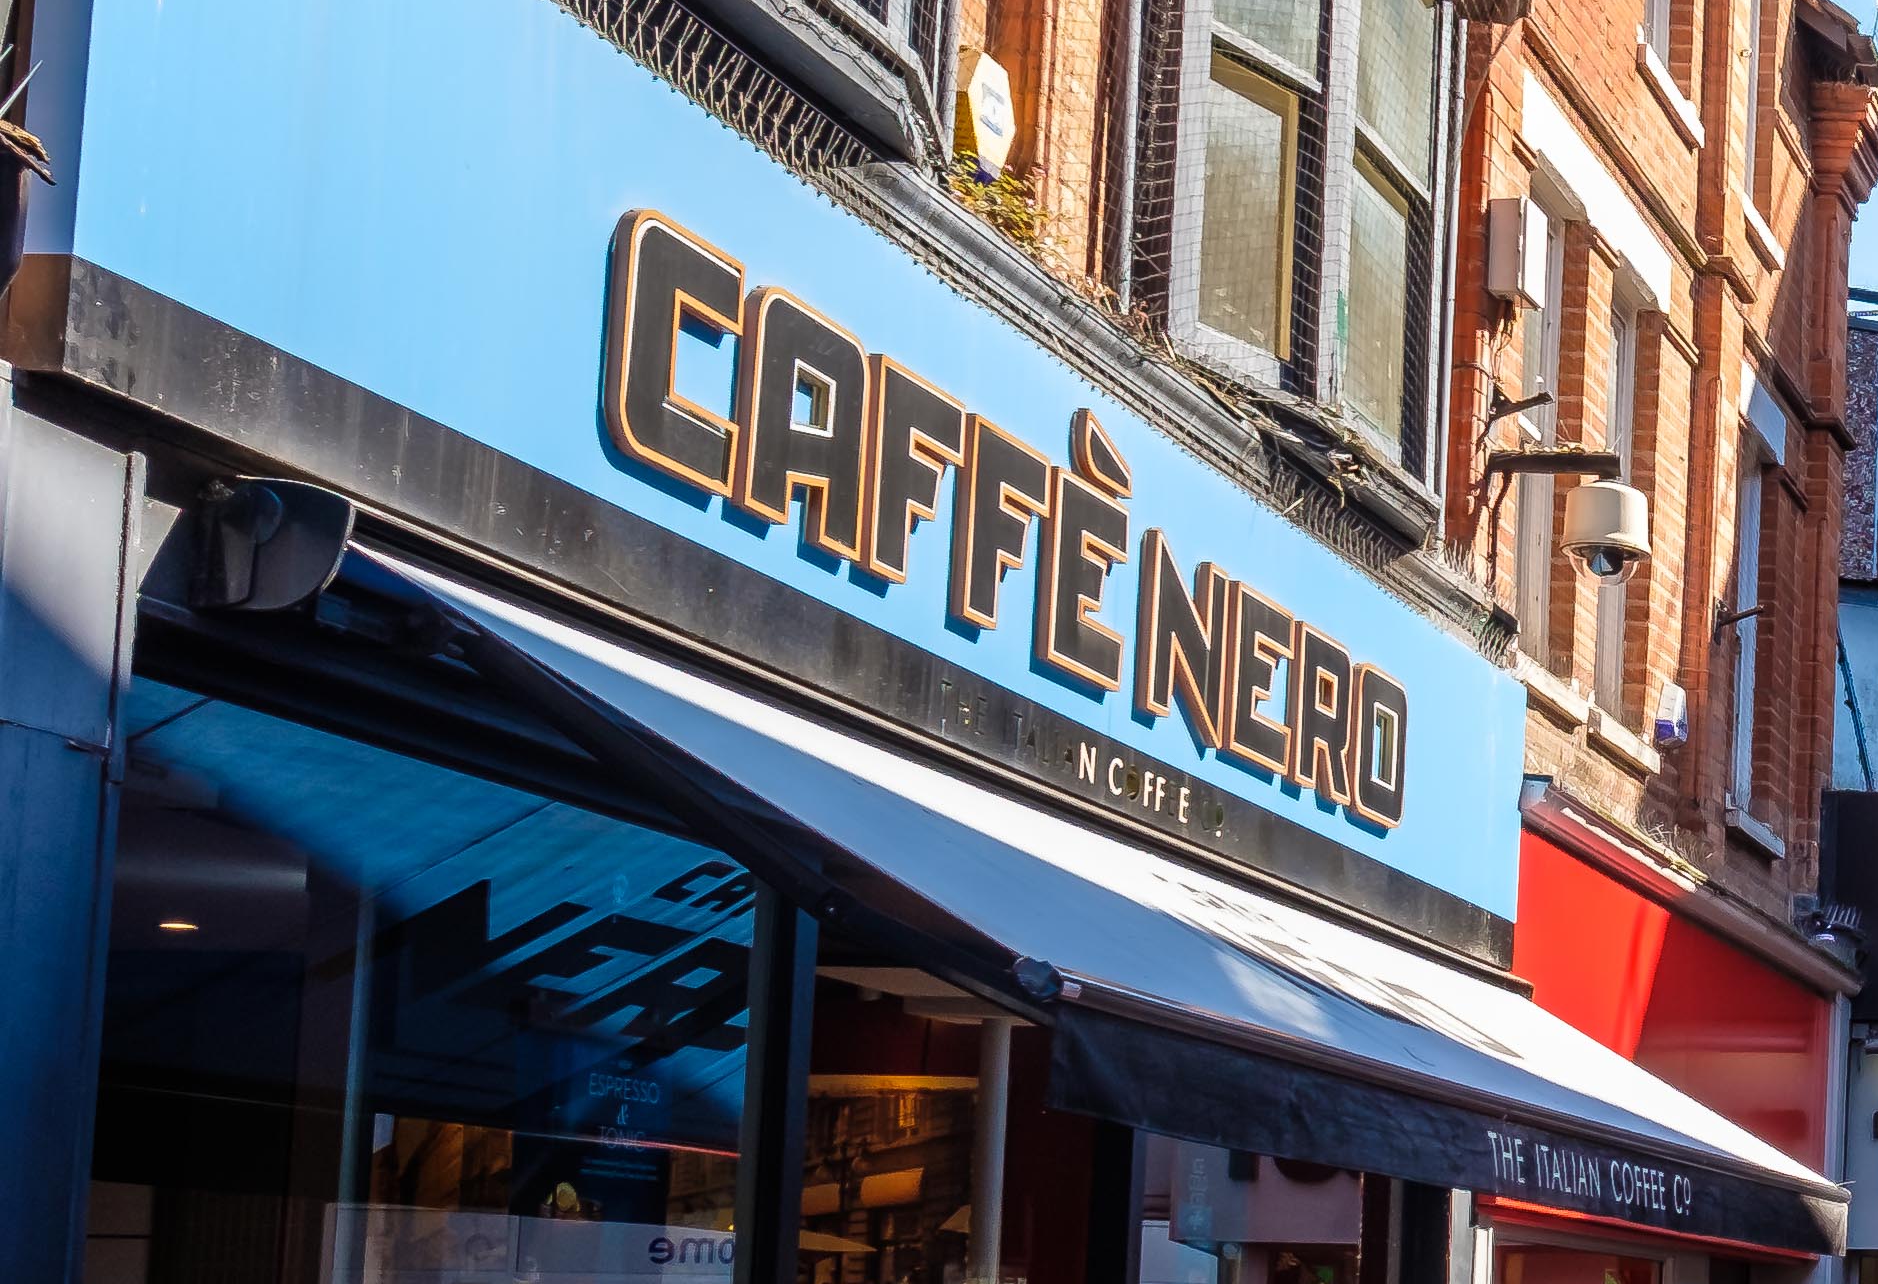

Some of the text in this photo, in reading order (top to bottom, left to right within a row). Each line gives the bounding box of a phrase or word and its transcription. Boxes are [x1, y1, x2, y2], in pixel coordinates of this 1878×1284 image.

[604, 208, 1407, 830] CAFFÈ NERO
[1487, 1130, 1526, 1184] THE
[1535, 1143, 1600, 1198] ITALIAN
[1610, 1160, 1666, 1210] COFFEE
